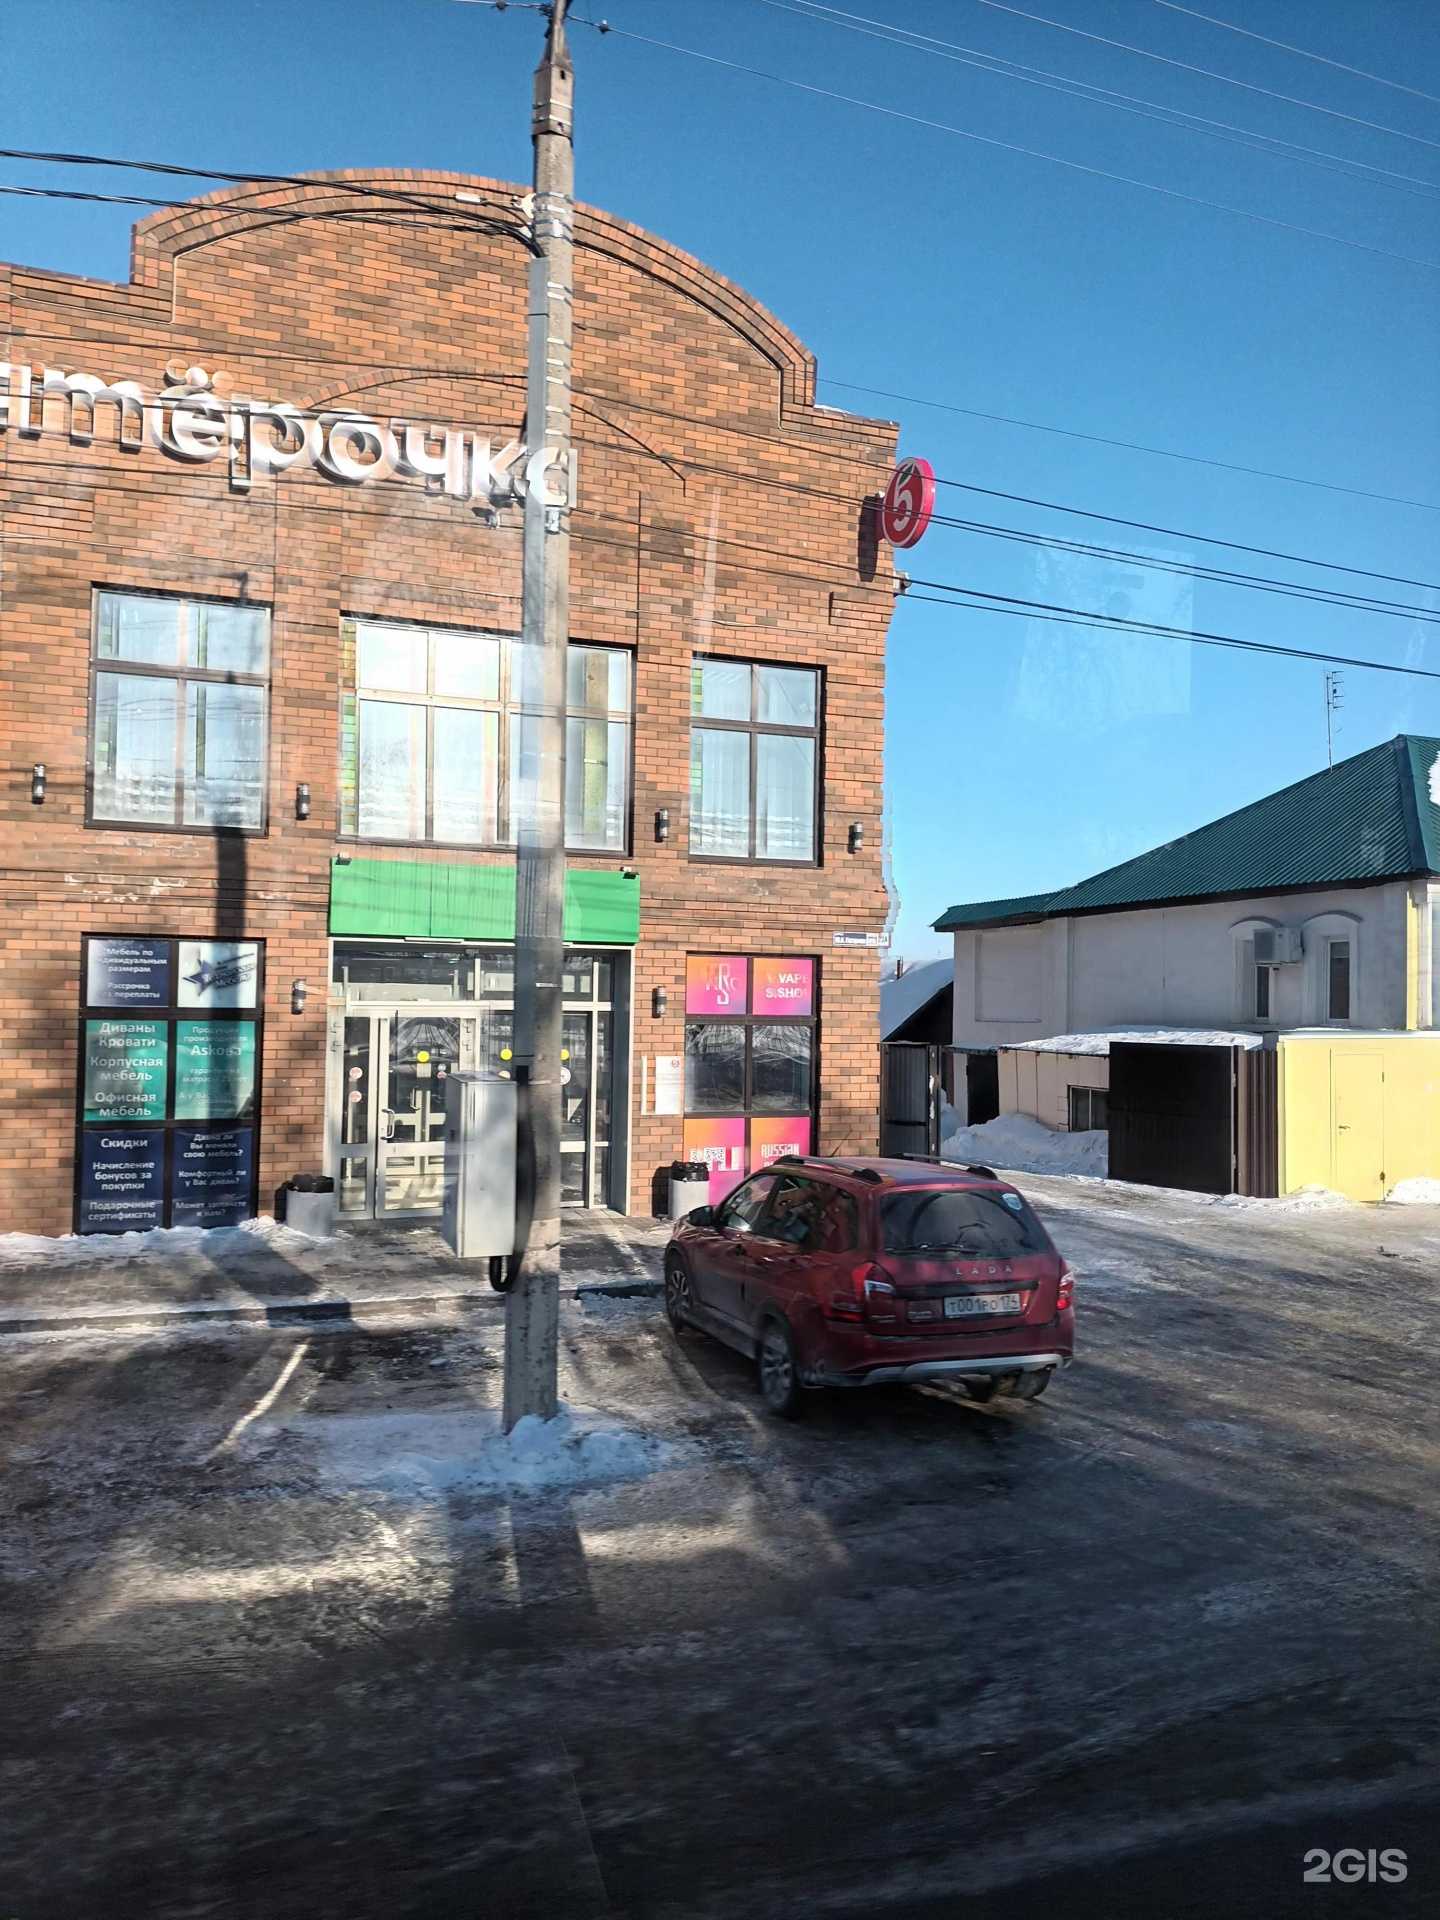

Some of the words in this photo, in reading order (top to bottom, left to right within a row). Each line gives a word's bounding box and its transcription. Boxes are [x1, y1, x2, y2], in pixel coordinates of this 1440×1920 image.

[99, 1022, 156, 1036] Диваны
[99, 1037, 156, 1048] Кровати
[90, 1056, 164, 1068] Корпусная
[94, 1091, 157, 1103] Офисная
[100, 1138, 148, 1149] Скидки
[92, 1161, 156, 1170] Начисление
[94, 1171, 137, 1181] бонусов
[101, 1182, 145, 1191] покупки
[89, 1200, 157, 1211] Подарочные
[88, 1211, 157, 1221] сертификаты
[955, 1264, 1012, 1275] LADA
